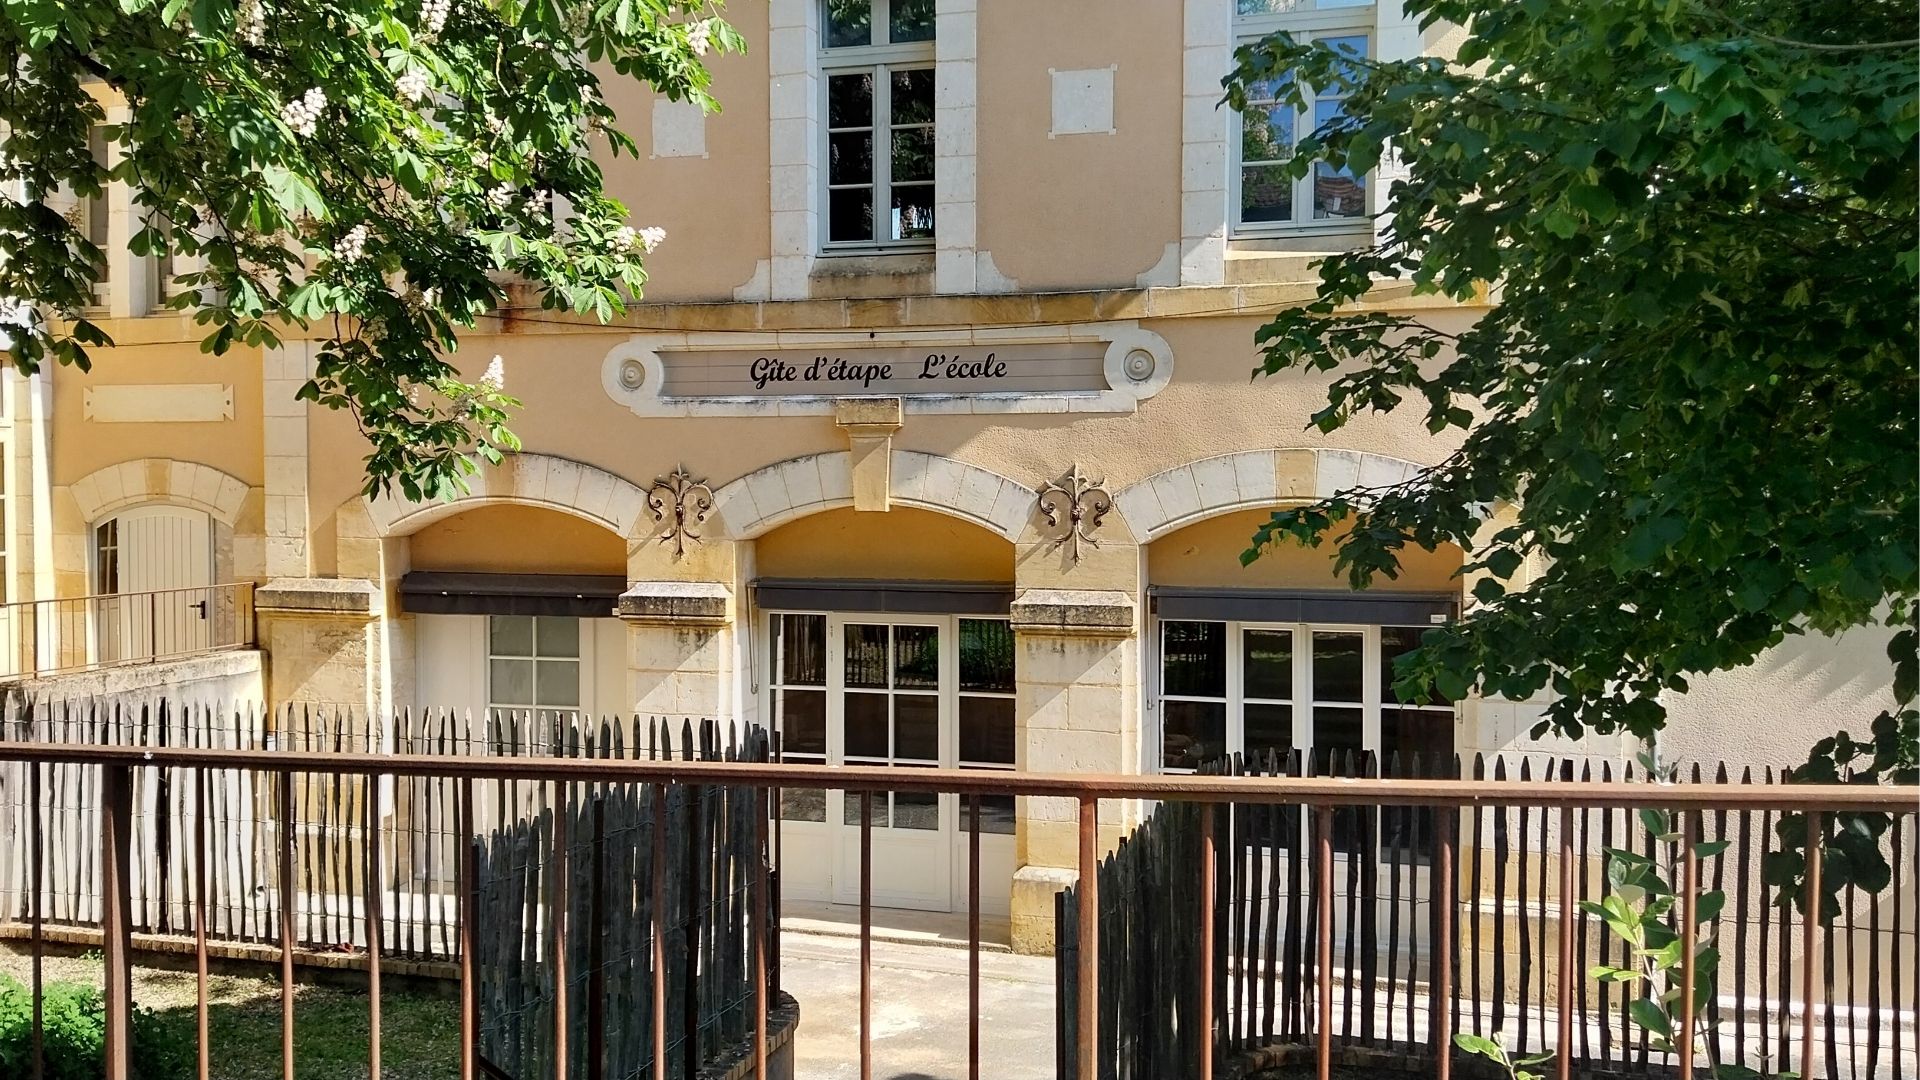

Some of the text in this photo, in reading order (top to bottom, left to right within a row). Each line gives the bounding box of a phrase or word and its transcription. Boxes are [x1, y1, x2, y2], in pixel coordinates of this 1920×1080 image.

[750, 352, 1008, 390] Gîte d'étape L'école
